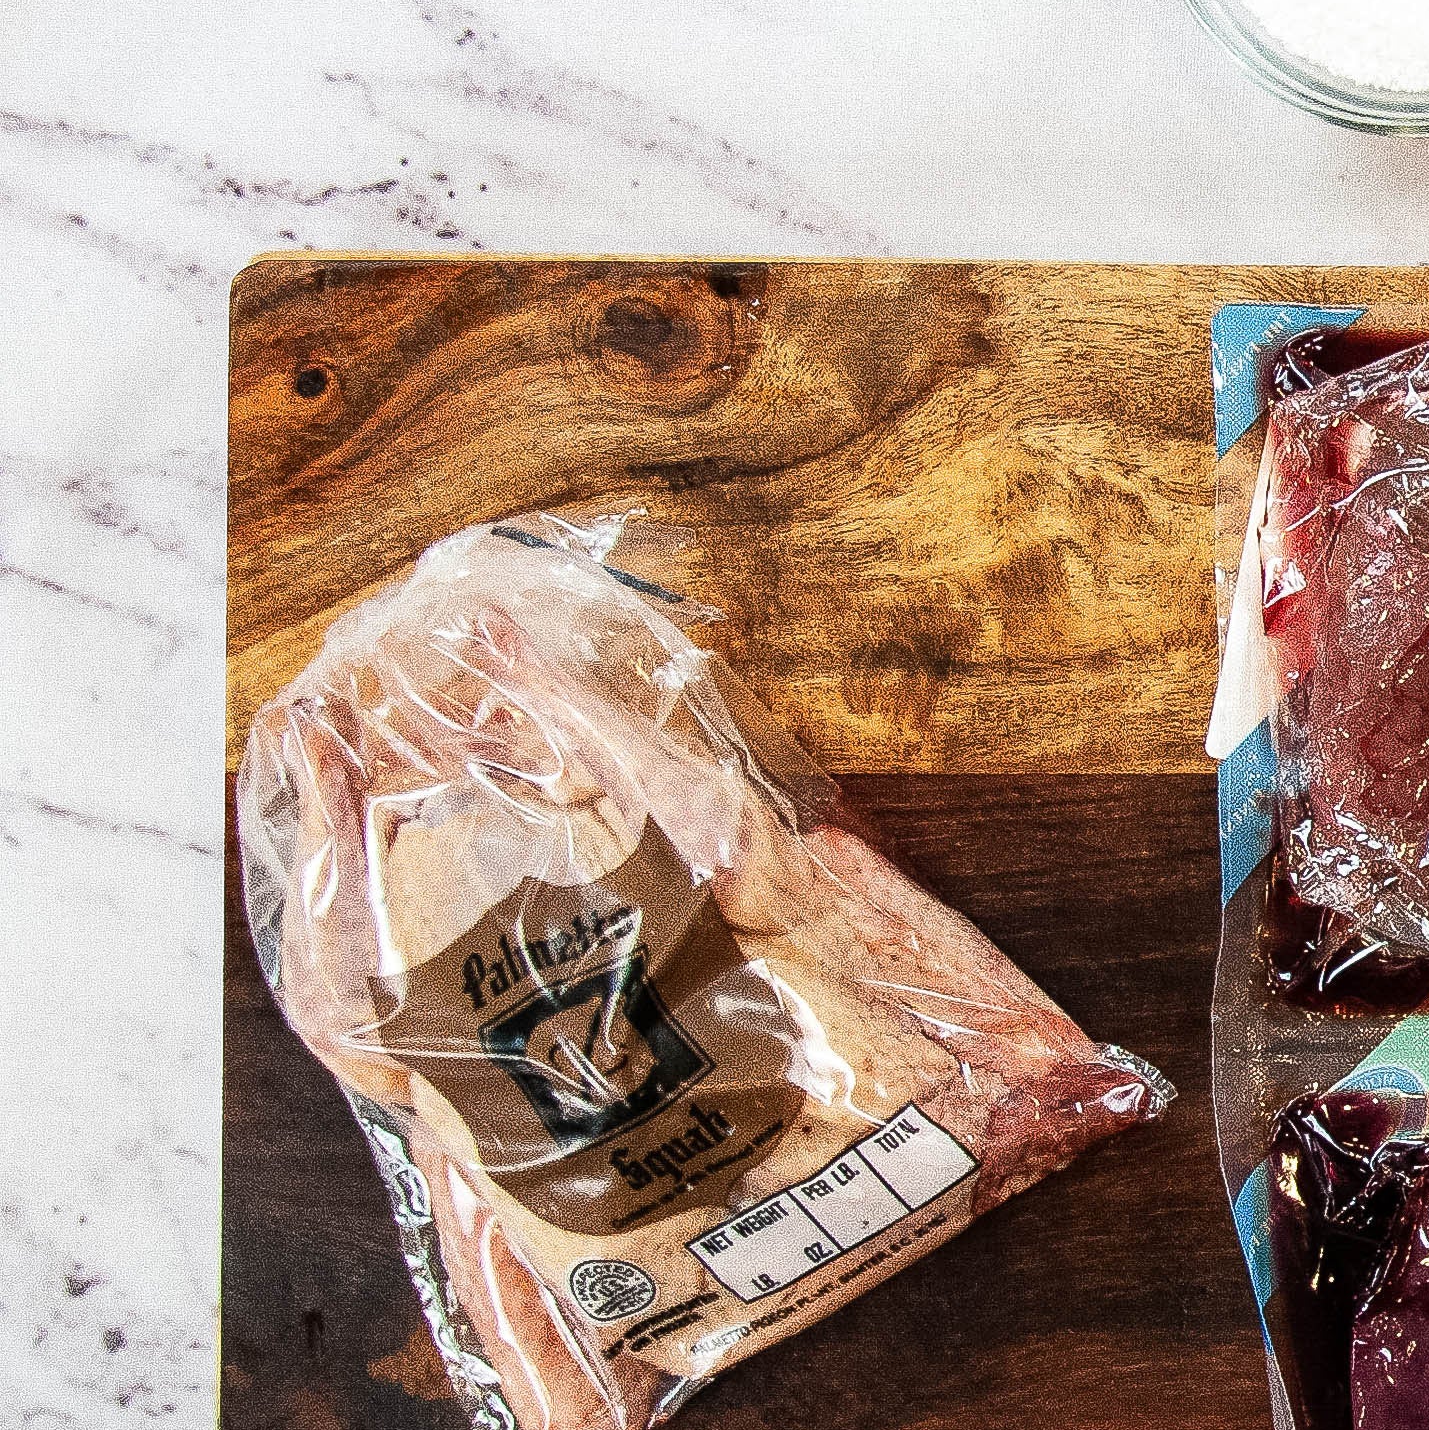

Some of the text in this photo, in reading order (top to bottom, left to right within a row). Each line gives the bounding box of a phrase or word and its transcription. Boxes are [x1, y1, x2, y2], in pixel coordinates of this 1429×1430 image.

[609, 1104, 735, 1189] Squab
[802, 1159, 860, 1202] PER LB.
[701, 1227, 730, 1257] NET
[803, 1239, 834, 1263] OZ.
[751, 1272, 781, 1293] LB.
